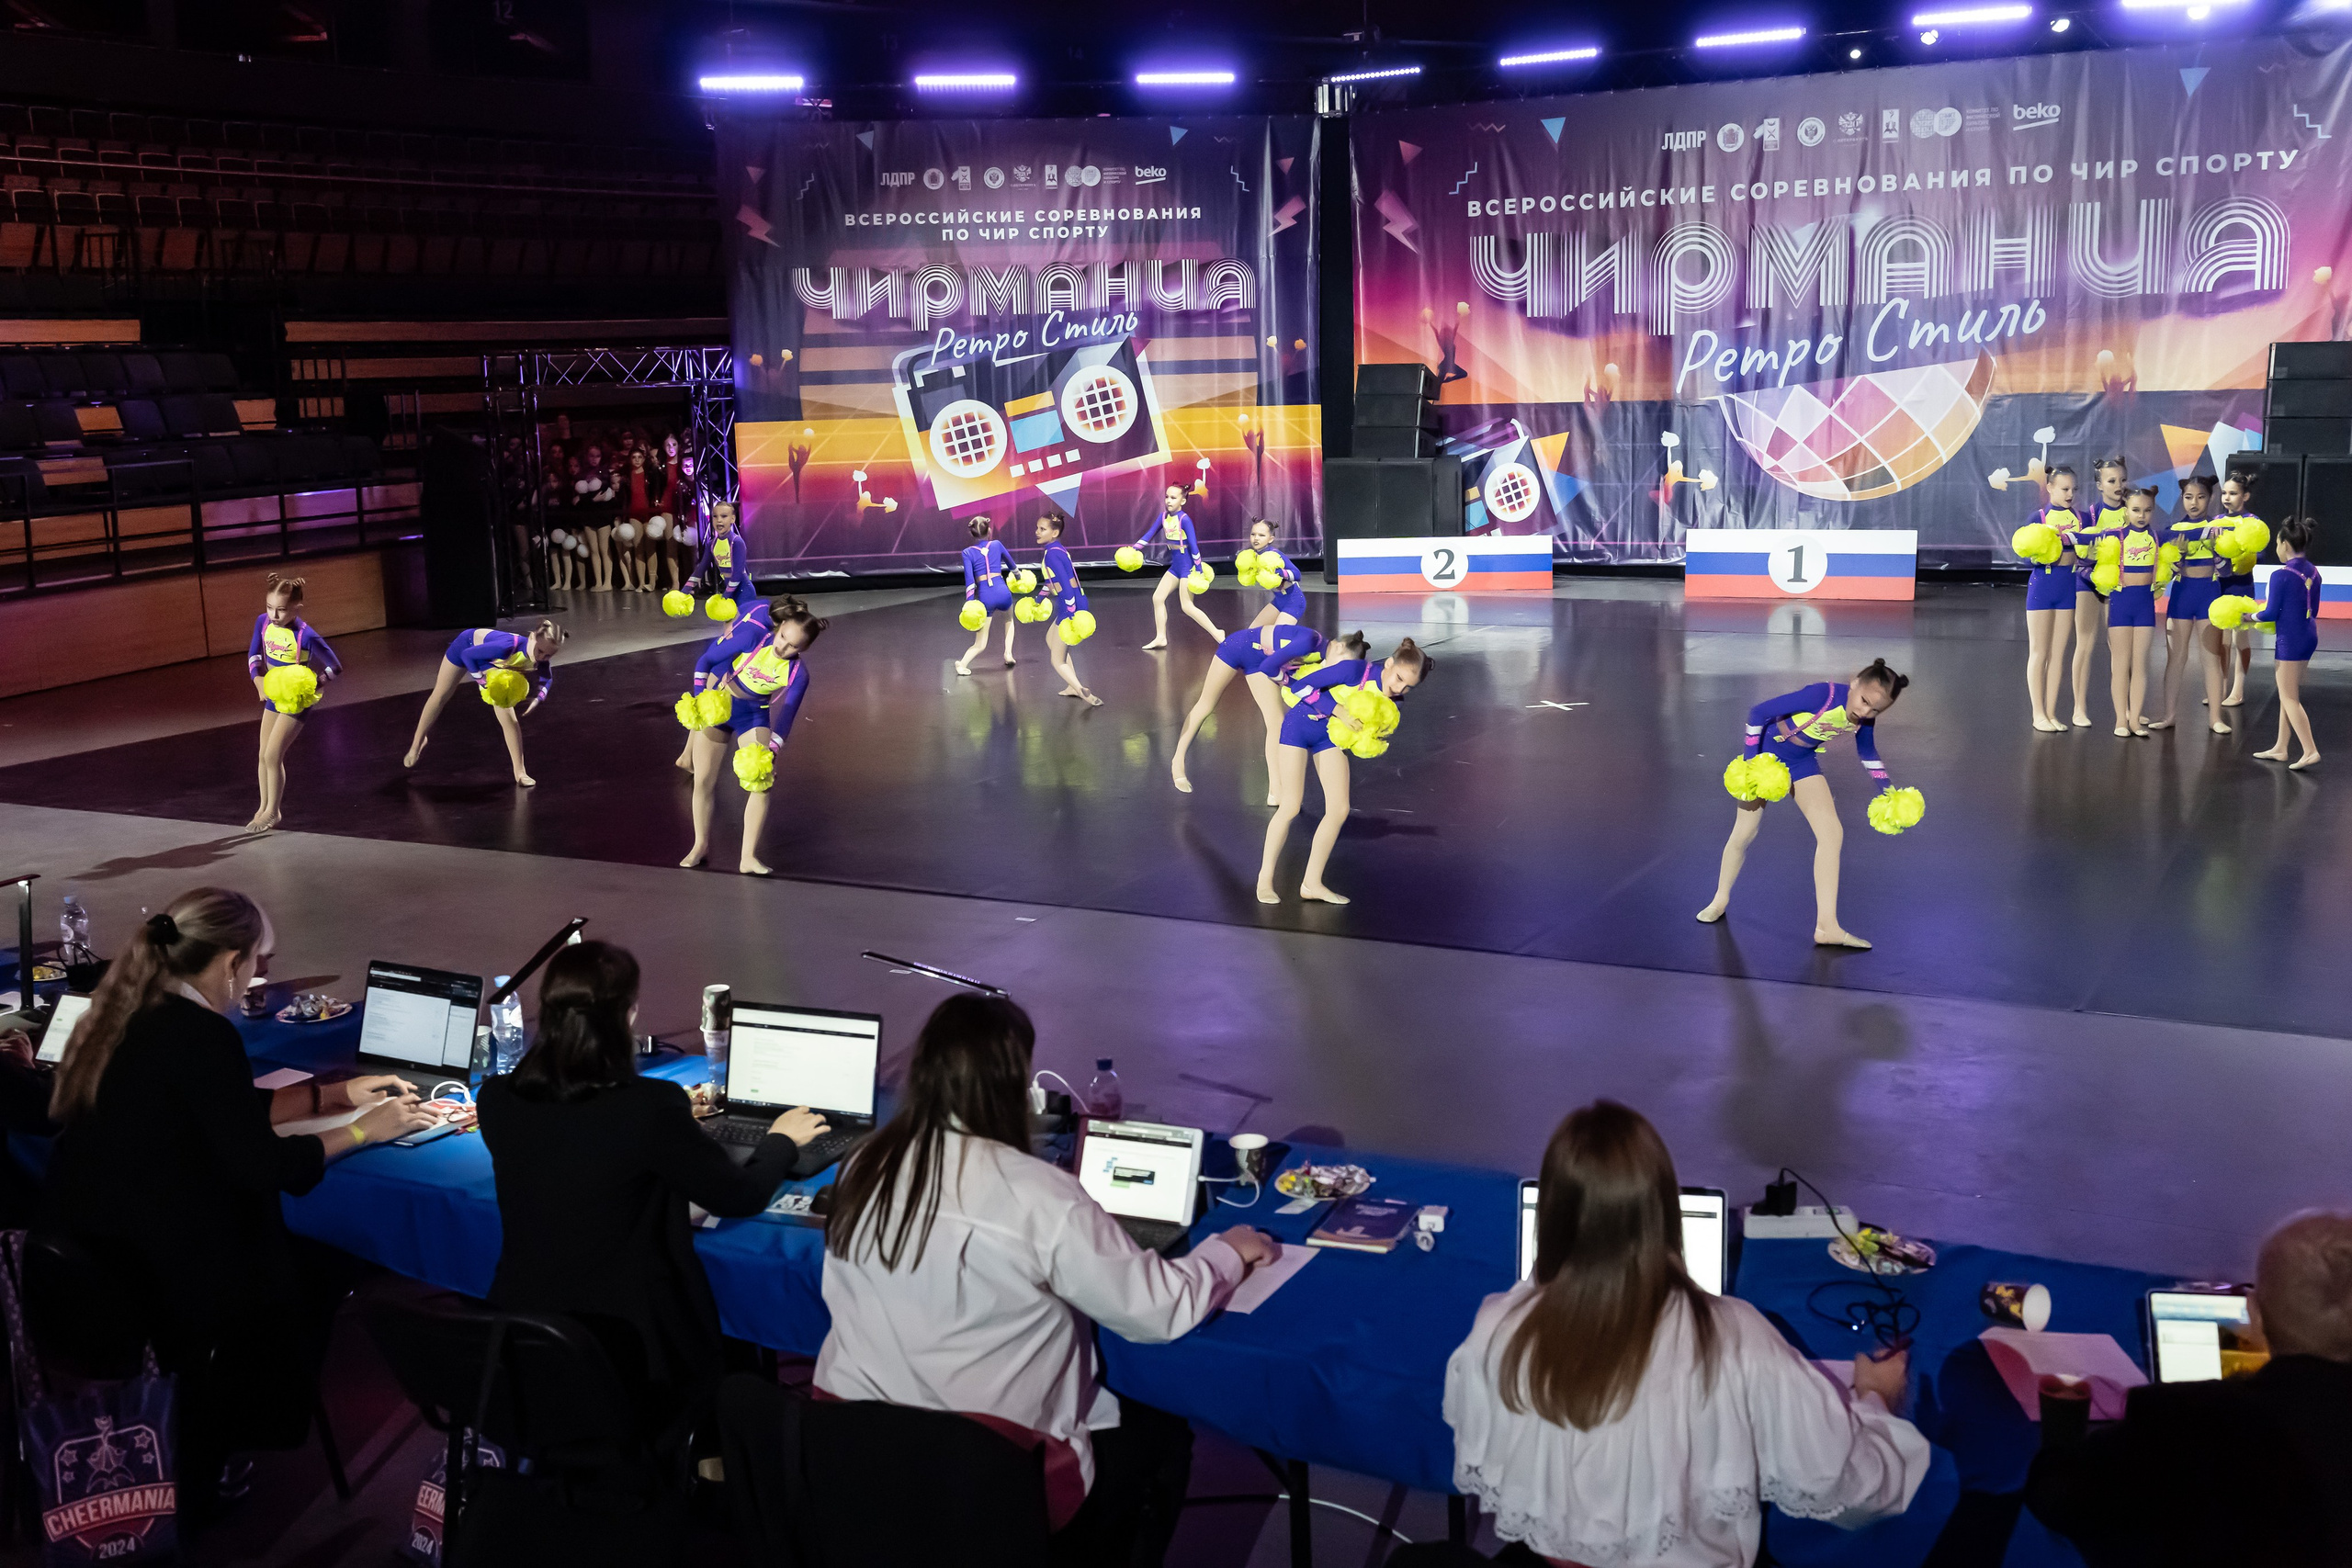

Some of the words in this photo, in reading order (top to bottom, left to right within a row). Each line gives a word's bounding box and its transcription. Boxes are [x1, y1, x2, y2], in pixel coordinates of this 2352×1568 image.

[2013, 103, 2062, 120] beko
[1661, 130, 1707, 152] ЛДПР
[880, 172, 916, 187] ЛДПР
[1135, 165, 1167, 178] beko
[1467, 184, 1715, 218] ВСЕРОССИЙСКИЕ
[1731, 168, 1991, 202] СОРЕВНОВАНИЯ
[2010, 164, 2053, 185] ПО
[2071, 159, 2139, 181] ЧИР
[2156, 149, 2301, 177] СПОРТУ
[845, 207, 1025, 226] ВСЕРОССИЙСКИЕ
[1035, 206, 1203, 224] СОРЕВНОВАНИЯ
[942, 227, 971, 242] ПО
[979, 226, 1021, 243] ЧИР
[1028, 224, 1110, 241] СПОРТУ
[931, 327, 1030, 367] Ретро
[1042, 309, 1139, 350] Стиль
[1677, 329, 1845, 395] Ретро
[1866, 297, 2047, 363] Стиль
[1432, 548, 1456, 581] 2
[1786, 545, 1808, 583] 1
[46, 1486, 175, 1536] CHEERMANIA
[98, 1537, 137, 1560] 2024
[412, 1531, 435, 1556] 2024
